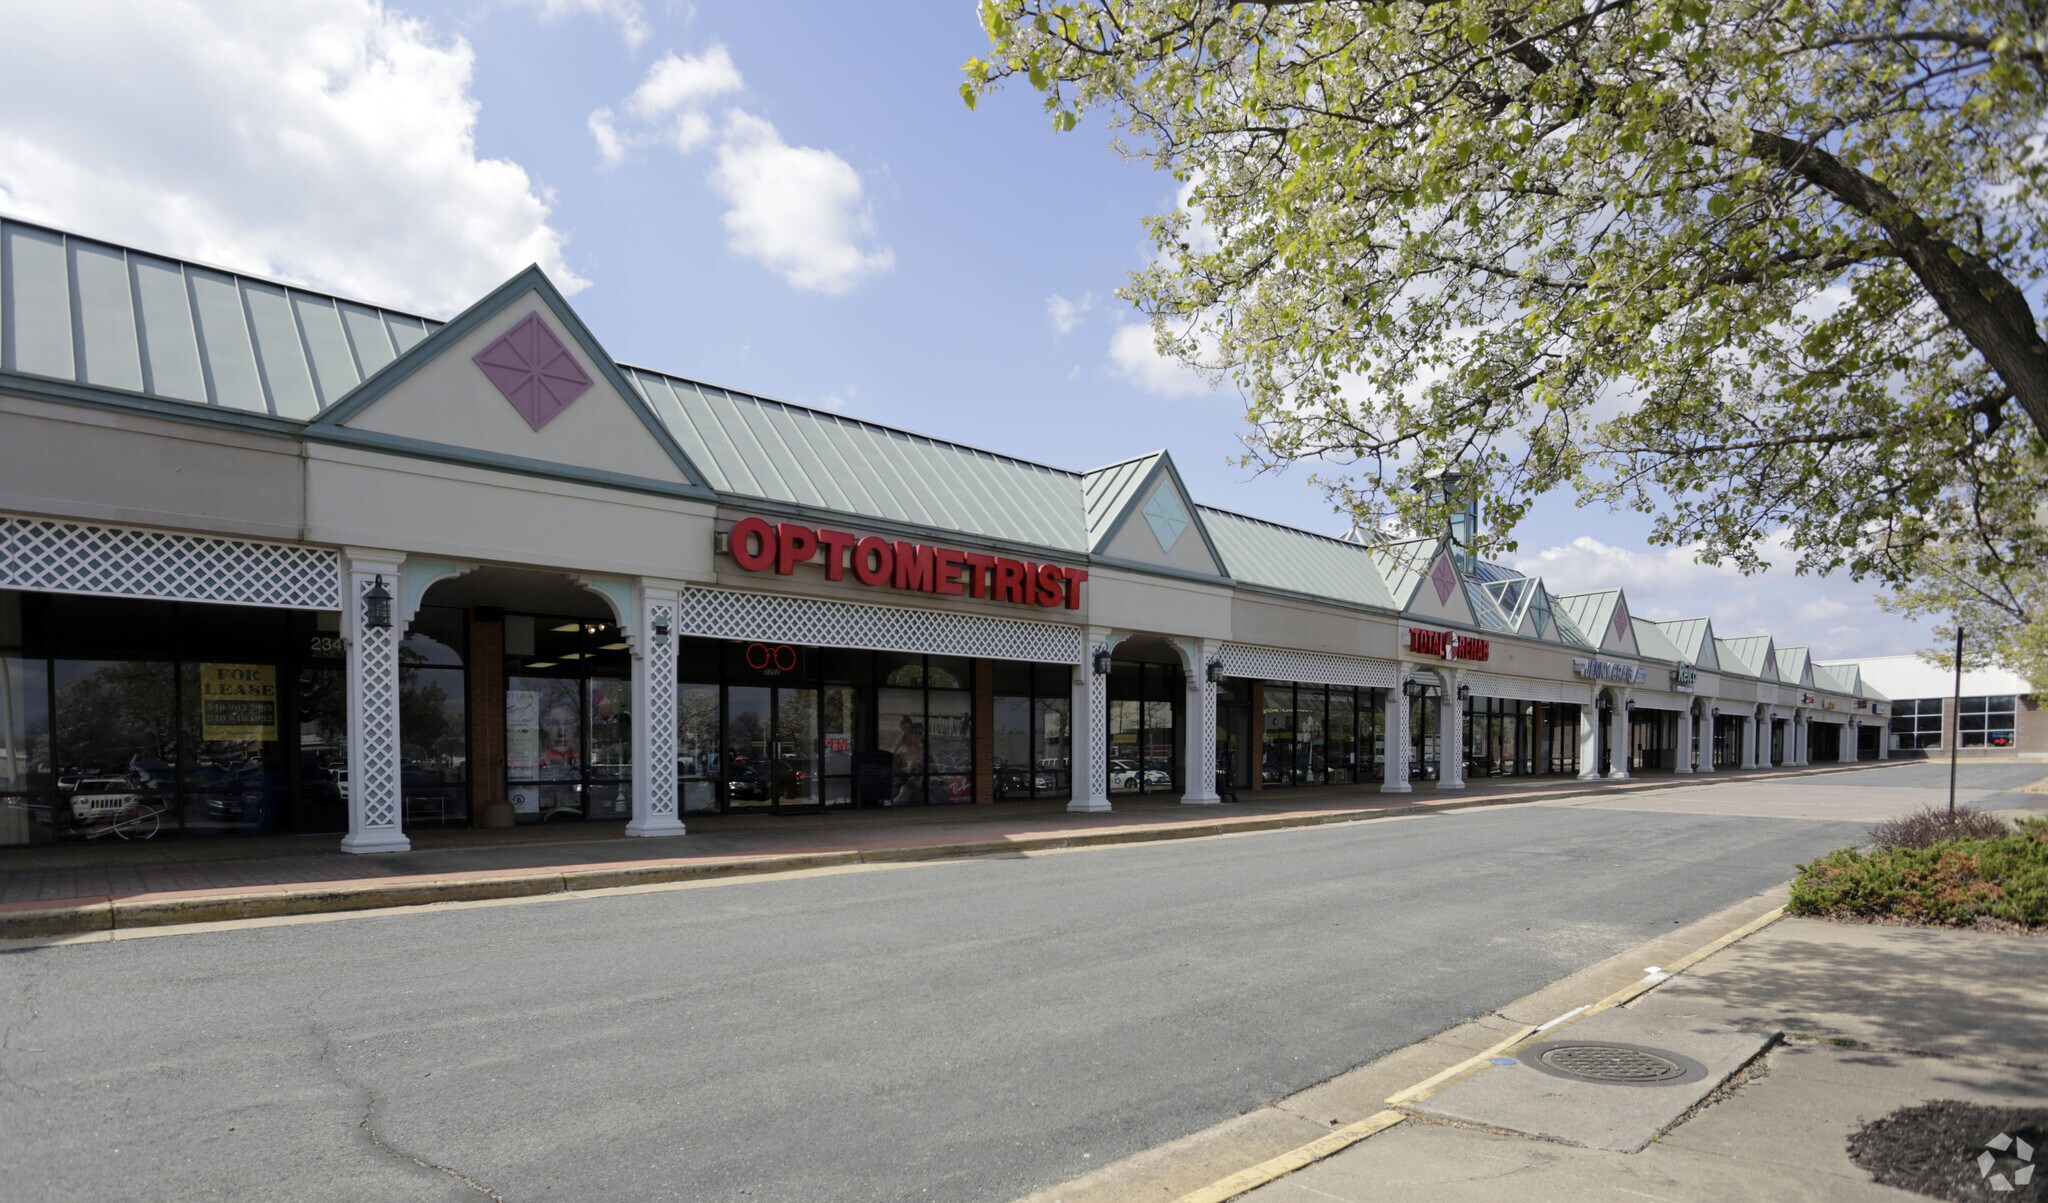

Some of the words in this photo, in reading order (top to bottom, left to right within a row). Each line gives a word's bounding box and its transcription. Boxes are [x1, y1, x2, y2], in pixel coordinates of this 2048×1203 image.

[728, 516, 1089, 610] OPTOMETRIST
[1409, 627, 1445, 659] TOTAL
[1457, 635, 1490, 662] REHAB
[217, 668, 259, 681] FOR
[1584, 658, 1610, 680] JENNY
[1611, 661, 1635, 684] CRAIG
[204, 683, 275, 696] LEASE
